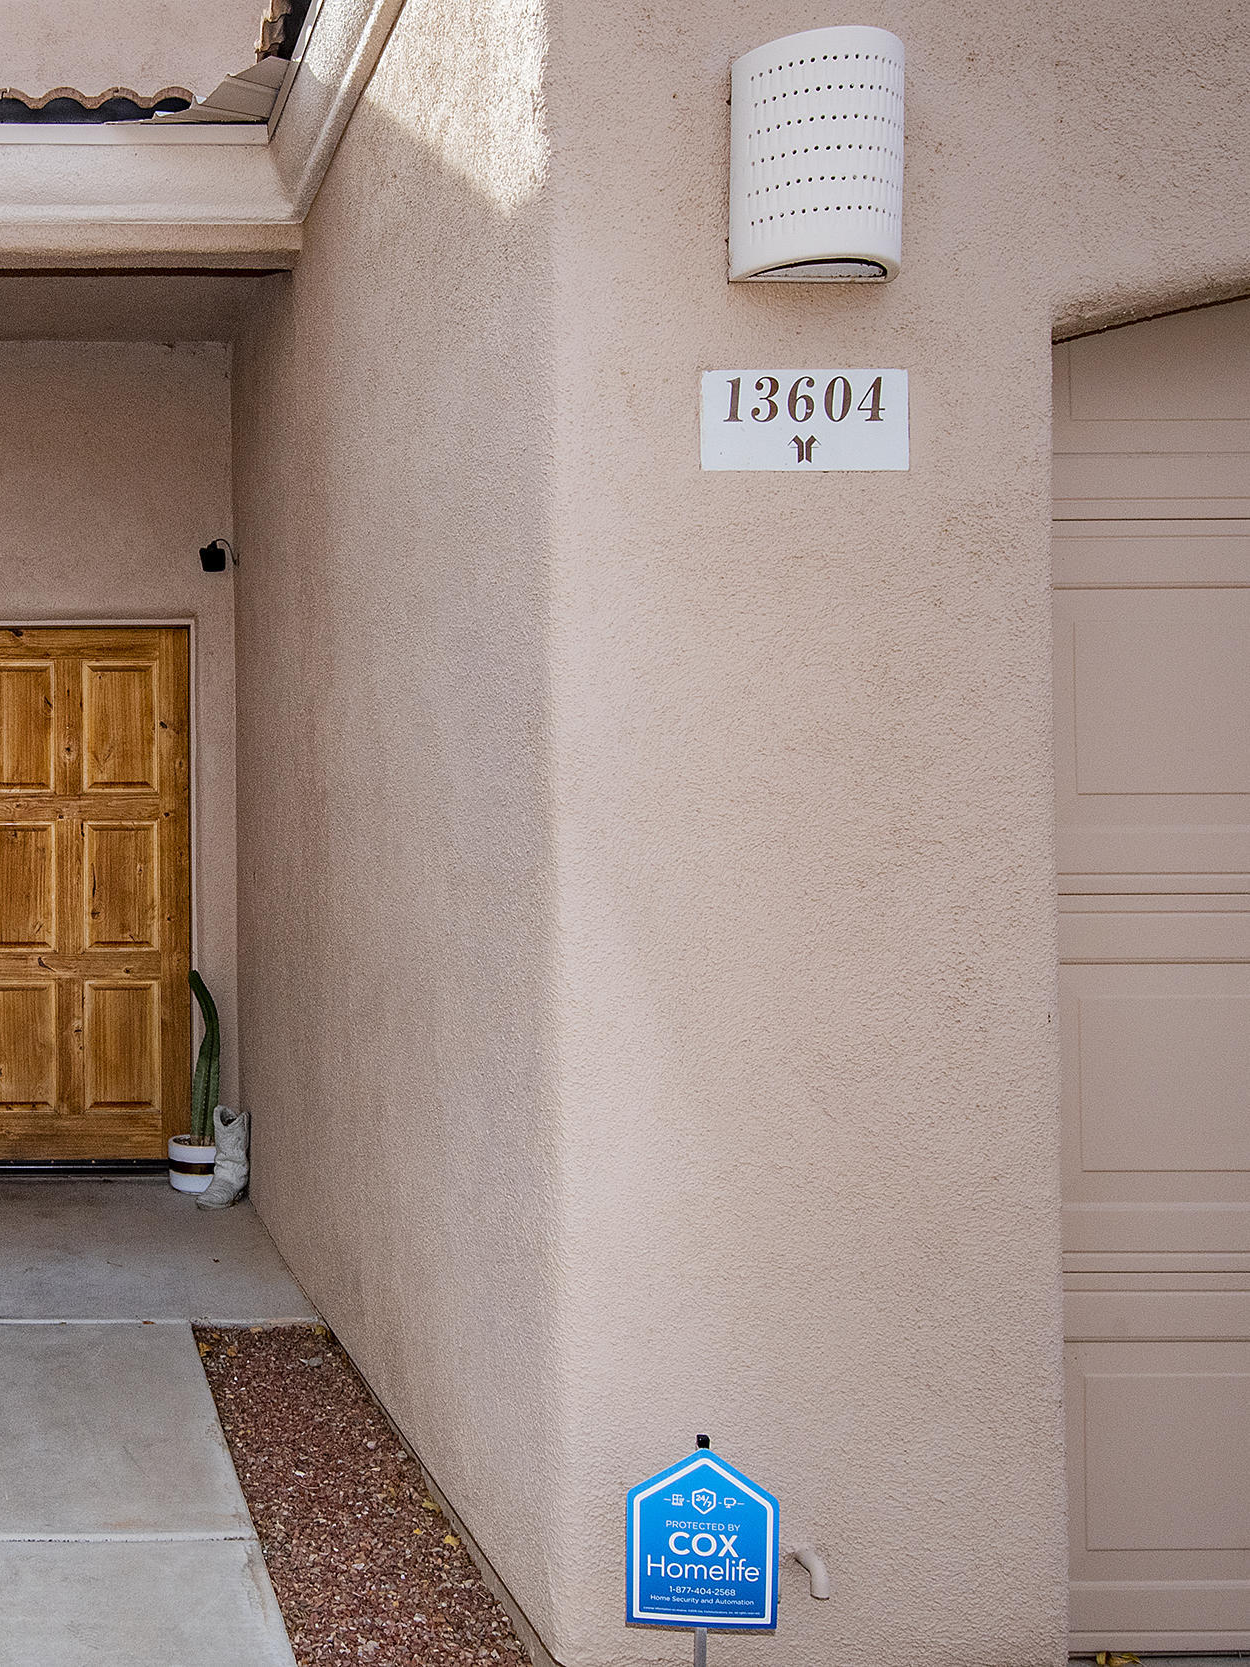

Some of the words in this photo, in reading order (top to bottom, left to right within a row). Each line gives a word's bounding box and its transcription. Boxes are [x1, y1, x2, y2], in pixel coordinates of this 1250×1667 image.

[723, 376, 886, 422] 13604
[695, 1494, 712, 1508] 24/7
[665, 1520, 725, 1531] PROTECTED
[727, 1523, 741, 1532] BY
[668, 1531, 739, 1558] COX
[647, 1554, 760, 1582] Homelife
[669, 1586, 736, 1597] 1-877-404-2568
[650, 1594, 671, 1602] Home
[672, 1596, 700, 1605] Security
[701, 1596, 713, 1604] and
[715, 1598, 755, 1606] Automation
